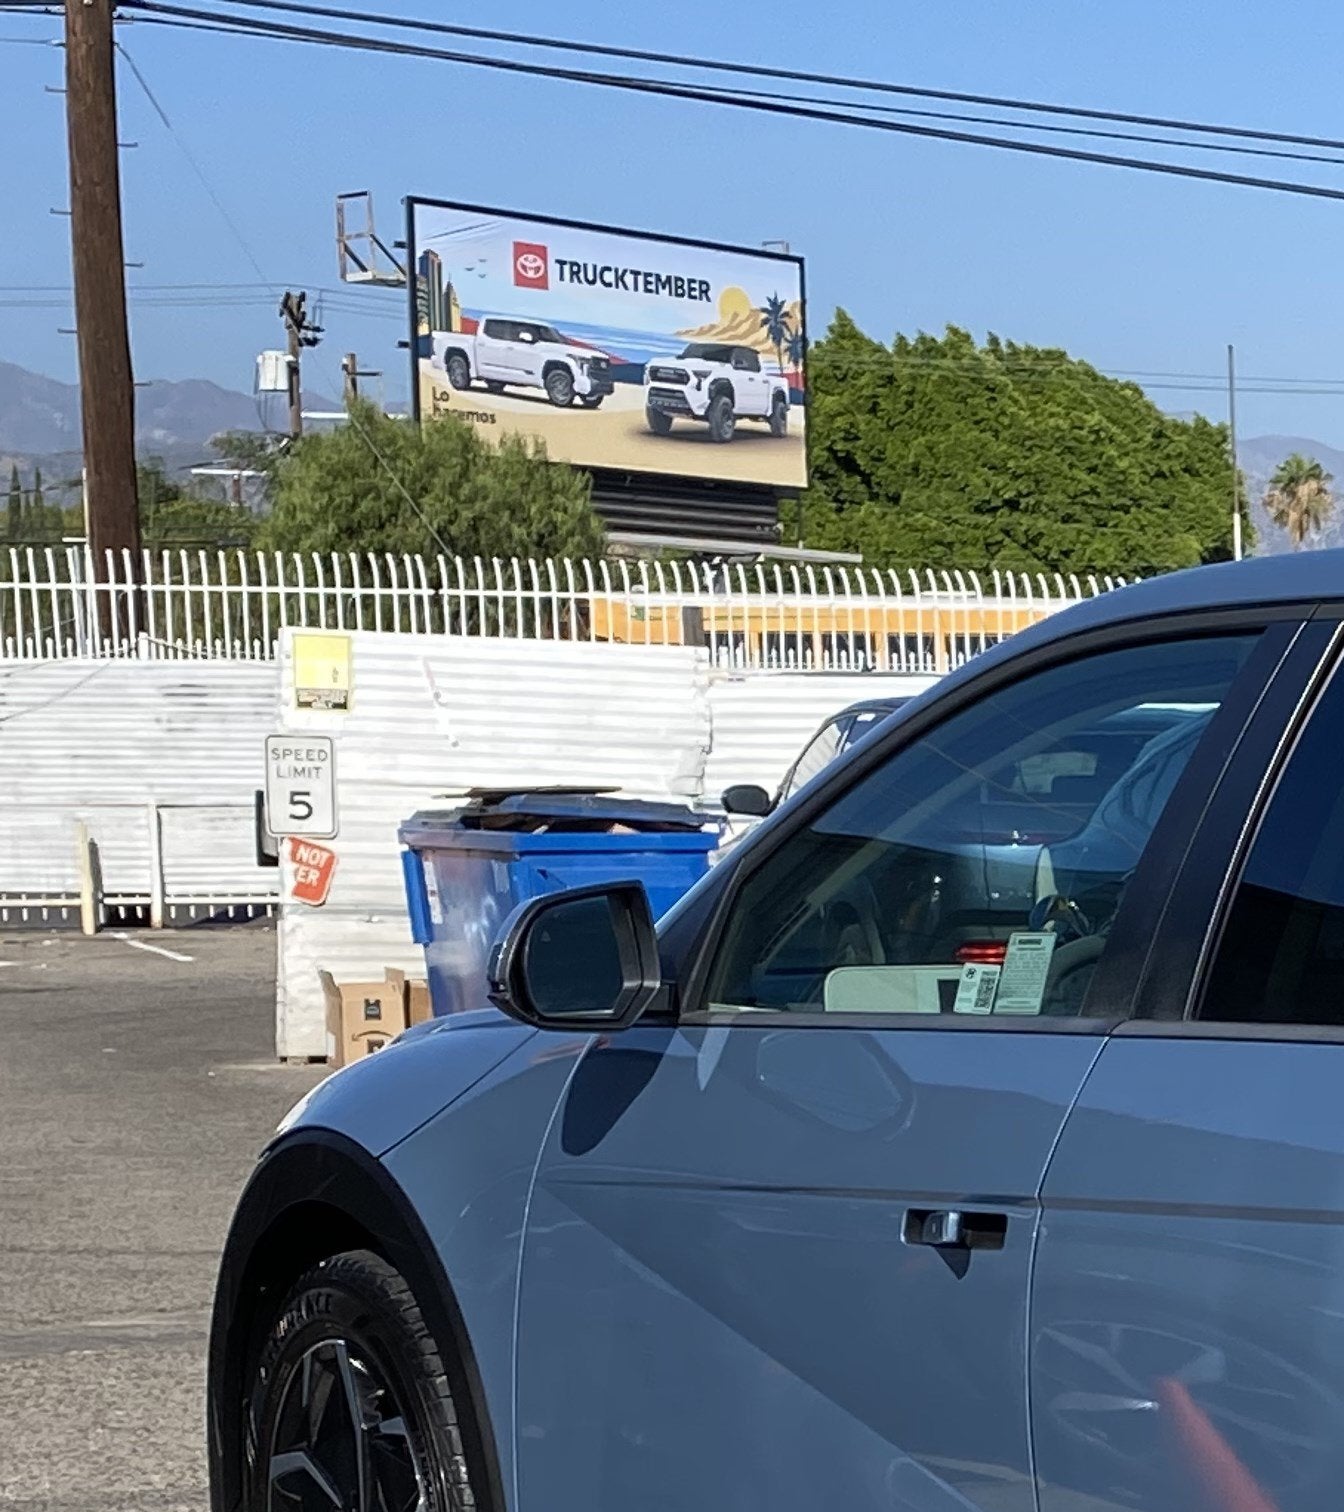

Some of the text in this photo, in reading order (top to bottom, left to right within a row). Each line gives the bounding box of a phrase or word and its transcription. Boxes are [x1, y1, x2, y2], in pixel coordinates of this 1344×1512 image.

[554, 258, 712, 302] TRUCKTEMBER
[431, 386, 450, 402] Lo
[271, 747, 328, 762] SPEED
[276, 766, 323, 779] LIMIT
[288, 790, 313, 821] 5
[295, 844, 331, 869] NOT
